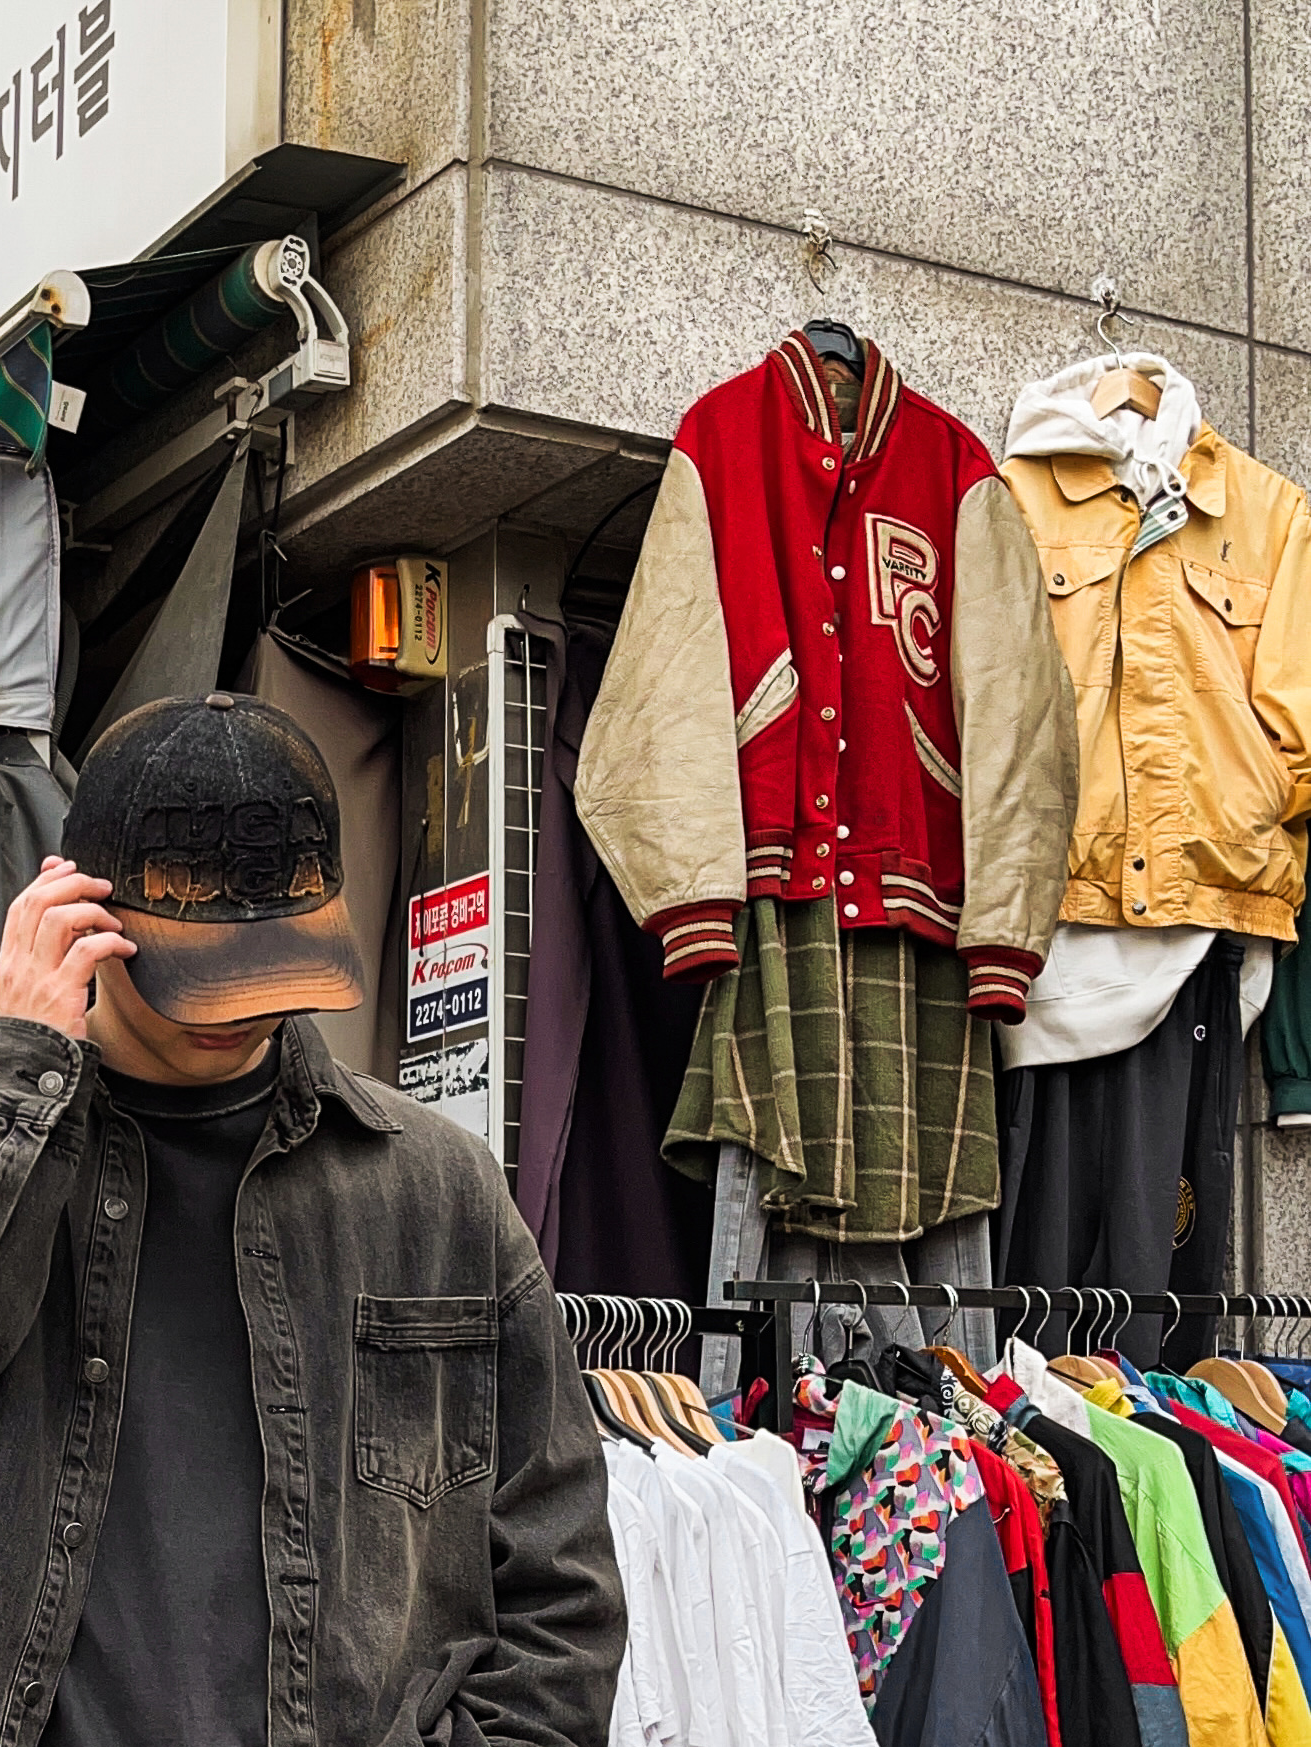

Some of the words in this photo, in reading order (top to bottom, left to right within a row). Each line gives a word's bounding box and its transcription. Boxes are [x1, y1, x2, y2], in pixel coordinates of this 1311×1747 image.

[414, 583, 424, 642] 2274-0112
[450, 889, 486, 929] 경비구역
[415, 987, 482, 1027] 2274-0112
